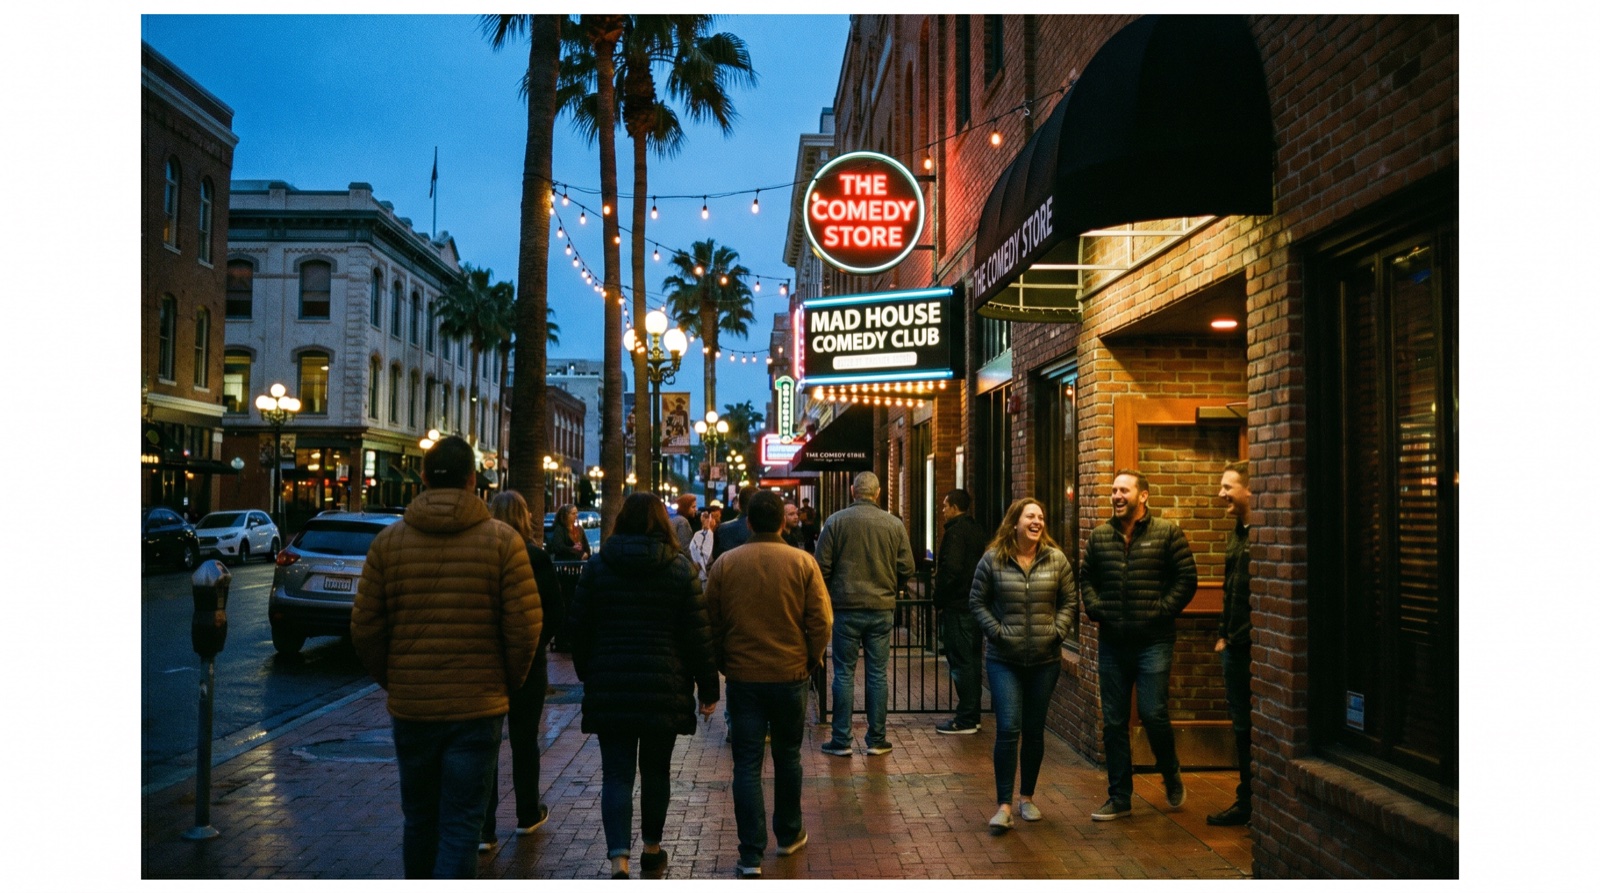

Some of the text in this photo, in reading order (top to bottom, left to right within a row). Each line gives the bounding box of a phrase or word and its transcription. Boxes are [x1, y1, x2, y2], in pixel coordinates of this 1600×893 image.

[839, 174, 887, 195] THE
[811, 200, 915, 221] COMEDY
[824, 225, 902, 247] STORE
[974, 195, 1053, 299] THE COMEDY STORE
[811, 302, 941, 332] MAD HOUSE
[812, 328, 940, 352] COMEDY CLUB
